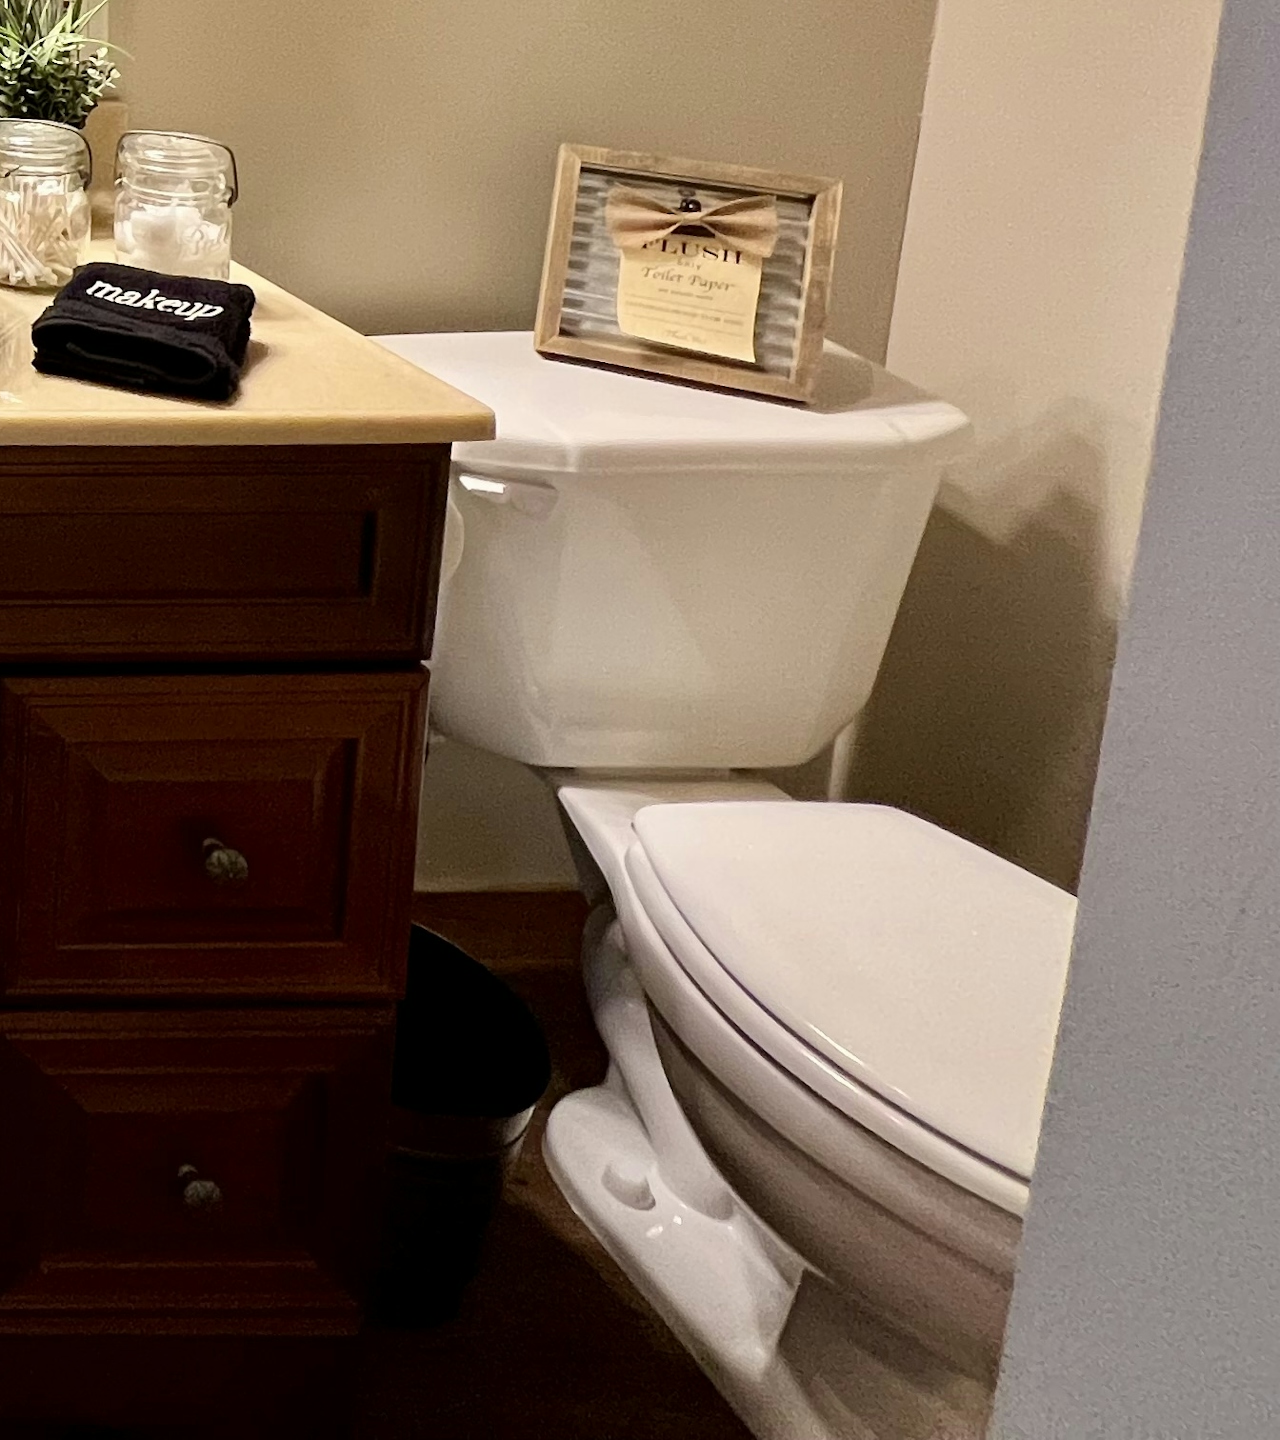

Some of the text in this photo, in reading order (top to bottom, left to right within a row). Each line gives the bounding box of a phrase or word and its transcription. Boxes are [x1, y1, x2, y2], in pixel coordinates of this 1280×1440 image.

[641, 266, 736, 293] Toilet Paper
[85, 280, 225, 321] makeup
